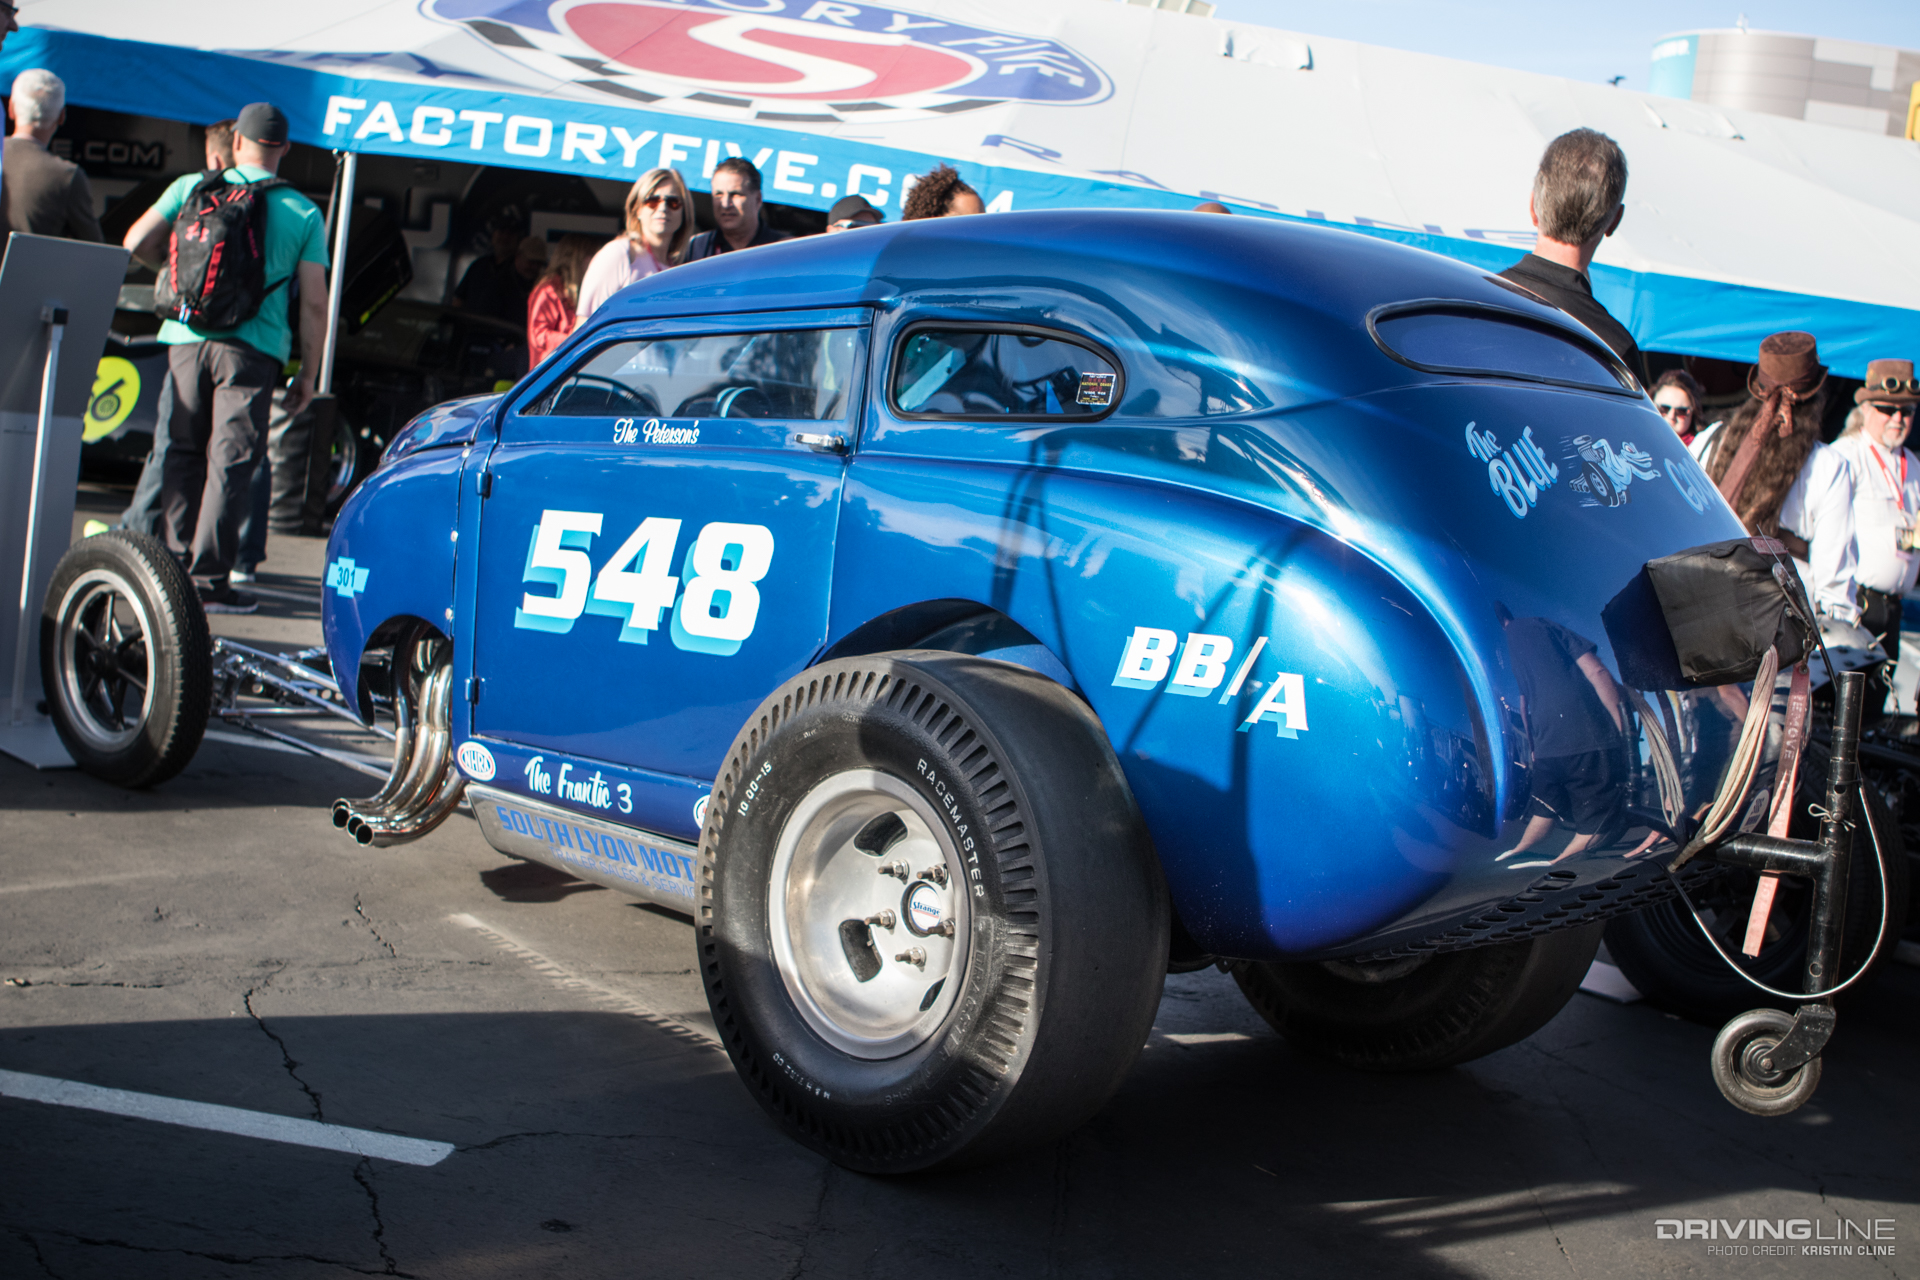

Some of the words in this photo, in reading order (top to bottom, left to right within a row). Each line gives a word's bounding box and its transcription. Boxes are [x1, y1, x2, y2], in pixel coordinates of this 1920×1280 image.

[322, 95, 1014, 213] FACTORYFIVE.C
[613, 418, 639, 444] The
[642, 418, 700, 444] Peterson's
[1465, 421, 1502, 463] The
[1488, 425, 1559, 519] BLUE
[337, 566, 356, 588] 301
[514, 509, 775, 656] 548
[1111, 626, 1309, 740] BB/A
[462, 750, 491, 773] NHRA
[524, 756, 551, 794] The
[557, 763, 613, 809] Frantic
[616, 783, 634, 814] 3
[496, 805, 574, 849] SOUTH
[573, 826, 638, 867] LYON
[637, 844, 697, 883] MOT
[917, 758, 985, 897] RACEMASTER
[548, 846, 599, 871] TRAILER
[599, 861, 640, 883] SALES
[640, 873, 651, 886] &
[913, 901, 940, 916] Strange
